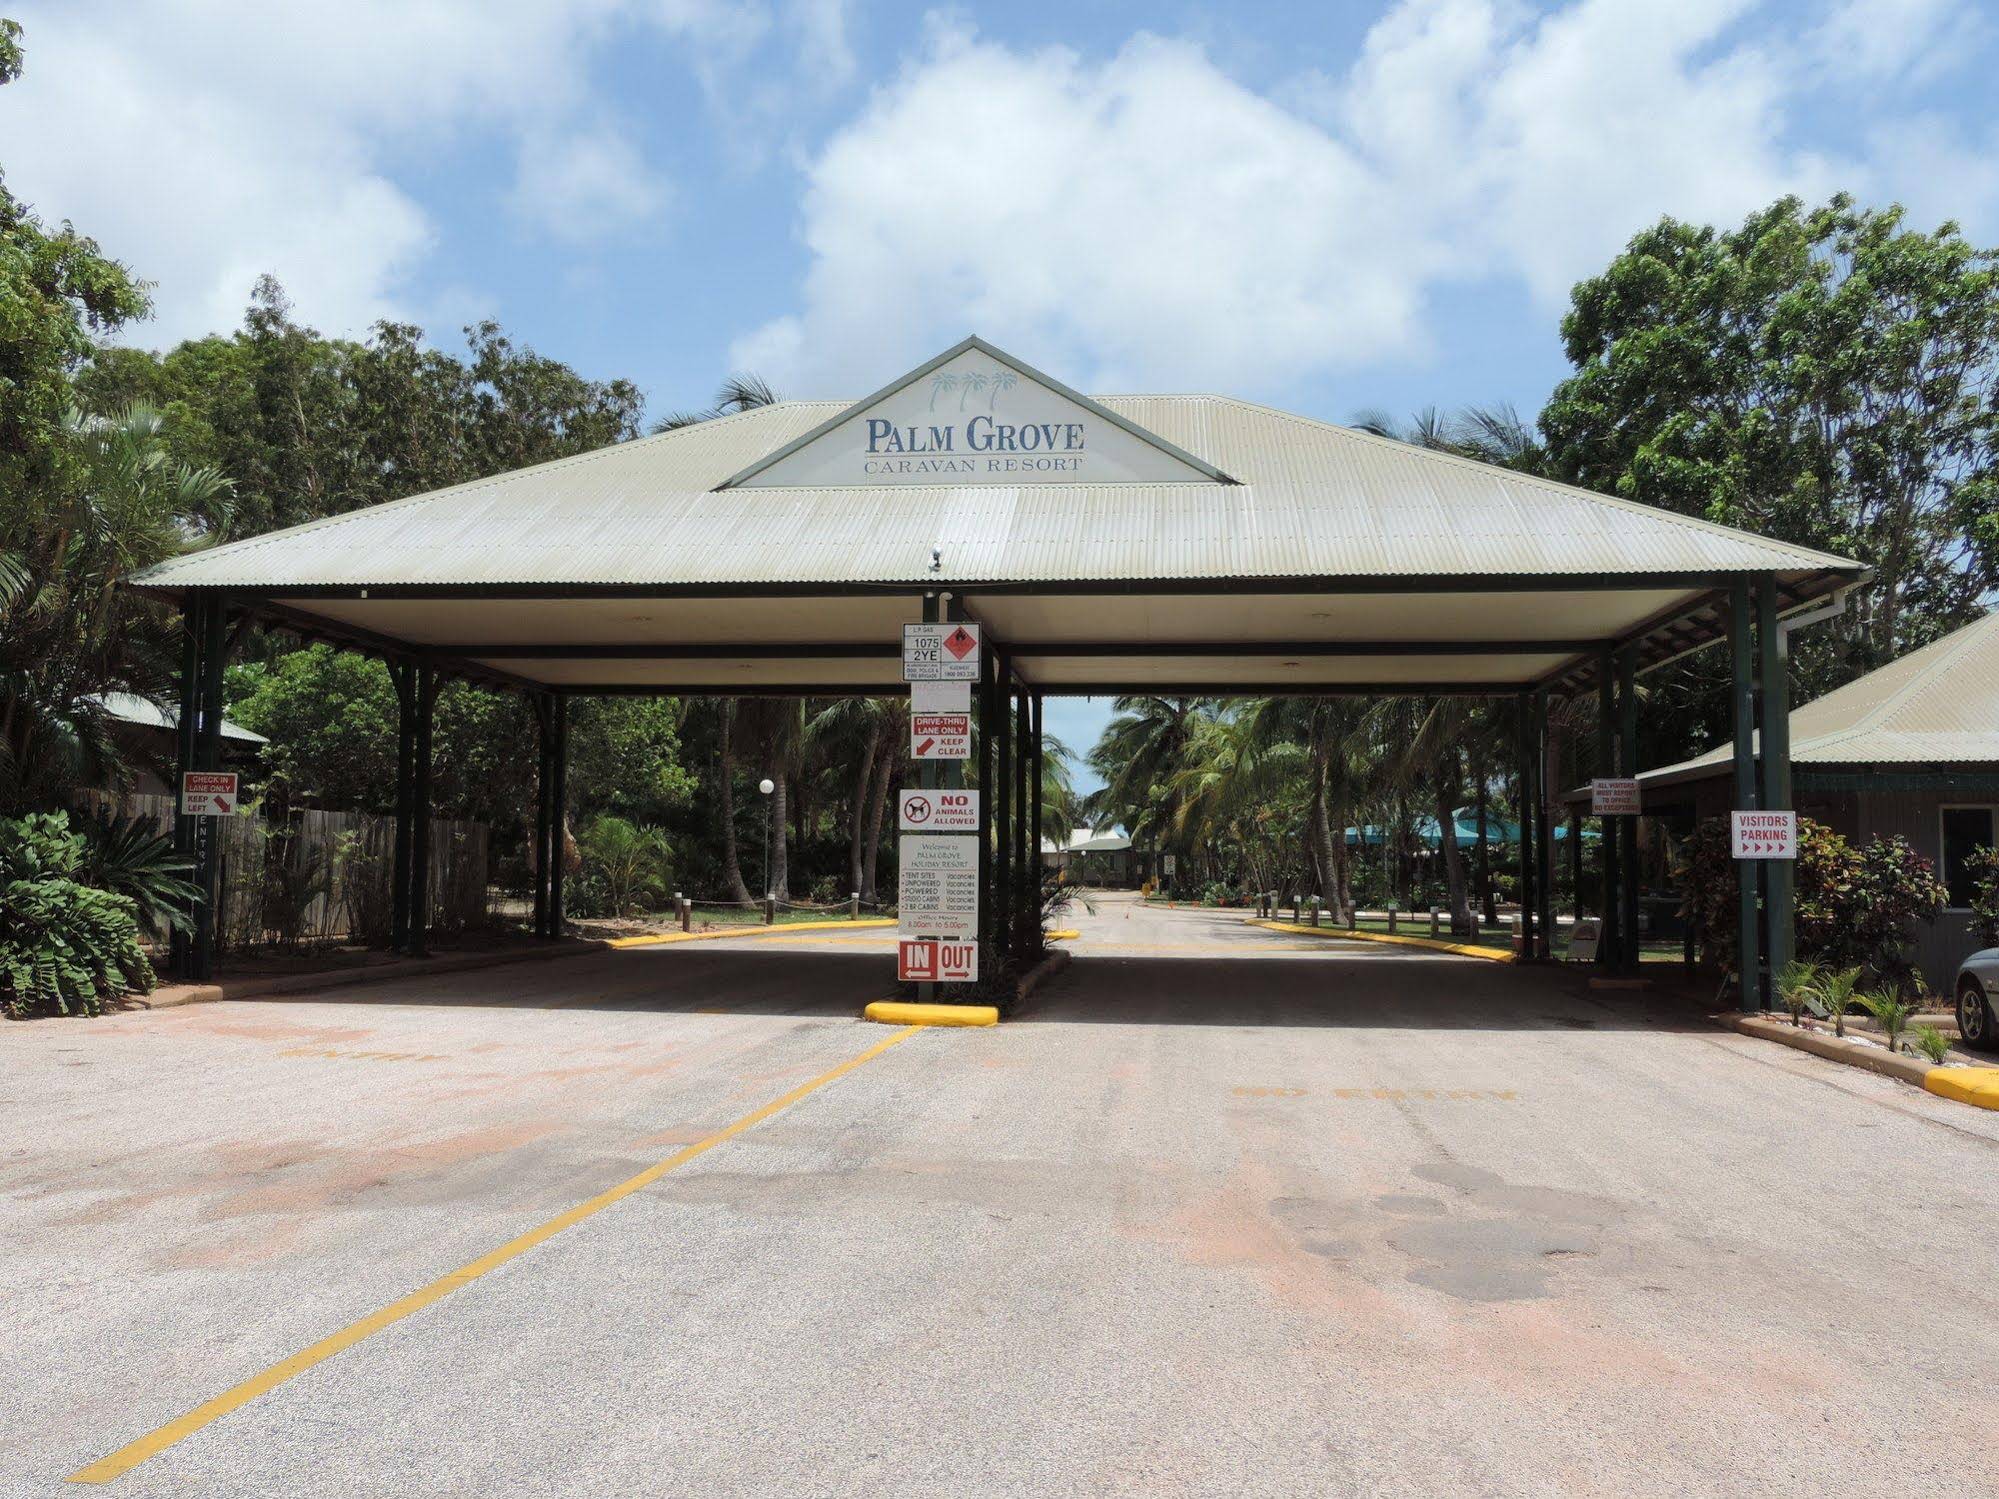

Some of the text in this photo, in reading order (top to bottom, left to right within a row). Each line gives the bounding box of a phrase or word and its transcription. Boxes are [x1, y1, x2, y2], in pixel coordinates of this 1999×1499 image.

[866, 415, 1084, 453] PALM GROVE
[864, 458, 1083, 475] CARAVAN RESORT
[914, 638, 939, 648] 1075
[914, 650, 937, 661] 2YE
[916, 717, 966, 726] DRIVE-THRU
[917, 727, 964, 736] LANE ONLY
[940, 738, 964, 746] KEEP
[937, 748, 967, 756] CLEAR
[192, 775, 229, 784] CHECK IN
[189, 784, 231, 793] LANE ONLY
[187, 795, 208, 803] KEEP
[941, 795, 969, 806] NO
[187, 804, 207, 812] LEFT
[935, 808, 974, 816] ANIMALS
[1739, 815, 1788, 827] VISITORS
[1740, 829, 1787, 841] PARKING
[906, 944, 930, 969] IN
[941, 945, 974, 969] OUT
